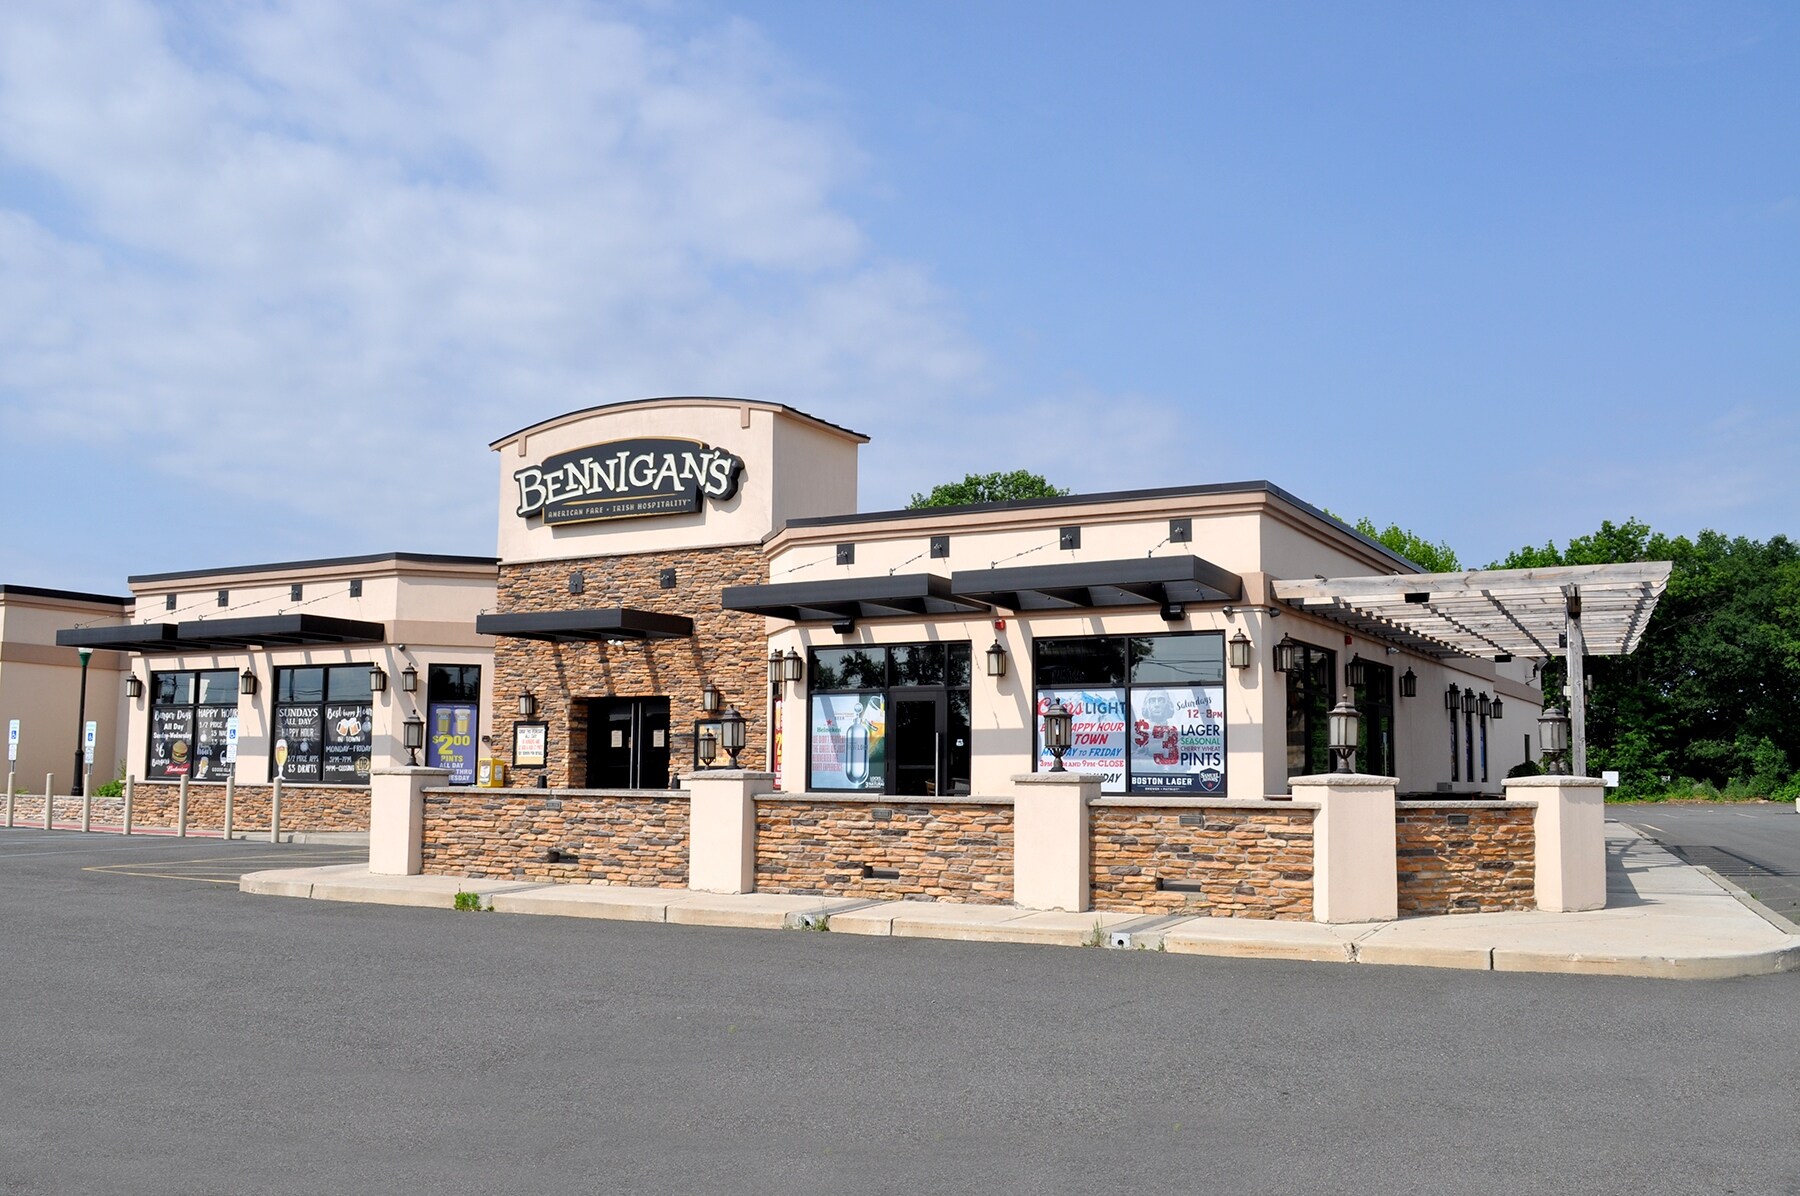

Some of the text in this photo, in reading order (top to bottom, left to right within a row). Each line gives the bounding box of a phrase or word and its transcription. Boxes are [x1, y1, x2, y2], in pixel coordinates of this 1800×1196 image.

[515, 451, 732, 514] BENNIGAN'S
[548, 500, 687, 518] AMERICAN FARE IRISH HOSPITALITY
[1086, 702, 1126, 714] LIGHT
[1177, 696, 1212, 711] Saturdays
[198, 709, 218, 718] HAPPY
[279, 708, 318, 717] SUNDAYS
[282, 728, 314, 737] HAPPY HOUR
[1072, 722, 1124, 732] APPY HOUR
[1181, 724, 1220, 736] LAGER
[1074, 734, 1108, 745] TOWN
[1134, 719, 1179, 765] $3
[1089, 748, 1122, 756] FRIDAY
[1181, 752, 1220, 766] PINTS
[298, 764, 317, 773] DRAFTS
[1132, 777, 1192, 786] BOSTON LAGER
